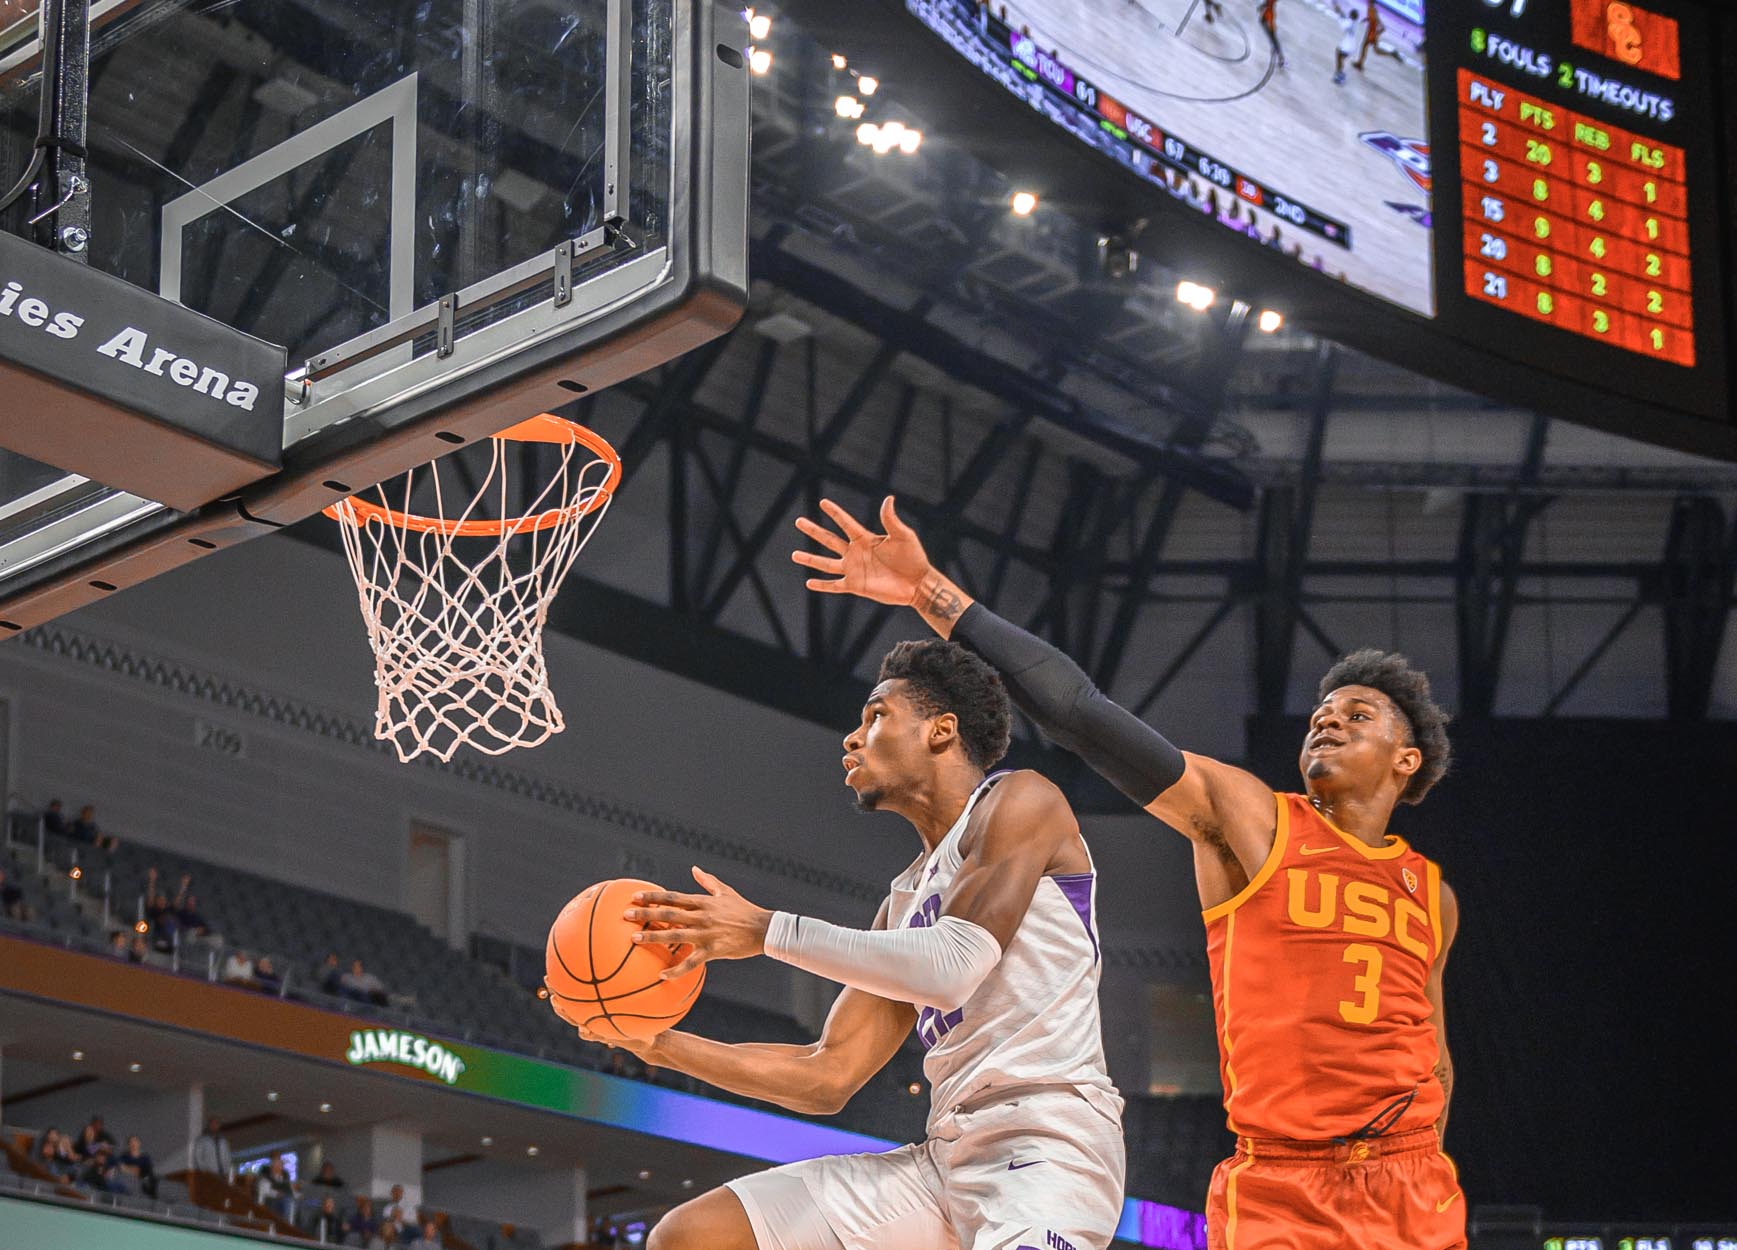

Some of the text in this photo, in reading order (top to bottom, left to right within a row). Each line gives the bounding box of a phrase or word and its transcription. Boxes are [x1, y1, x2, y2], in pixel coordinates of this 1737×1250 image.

[1487, 33, 1552, 78] FOULS
[1558, 62, 1575, 89] 2
[1575, 67, 1676, 122] TIMEOUTS
[1470, 81, 1665, 168] PLY PTS REB FLS
[1482, 122, 1656, 203] 2 20 3 1
[1483, 159, 1499, 183] 3
[1588, 200, 1604, 221] 4
[1645, 218, 1658, 240] 1
[1480, 233, 1507, 260] 20
[1591, 272, 1607, 296] 2
[1647, 290, 1663, 314] 2
[1589, 237, 1606, 258] 4
[1646, 253, 1661, 277] 2
[0, 282, 260, 411] ies Arena
[1483, 272, 1507, 299] 21
[1593, 310, 1609, 333] 3
[1650, 328, 1664, 350] 1
[1287, 868, 1429, 962] USC
[1338, 943, 1383, 1025] 3
[347, 1029, 461, 1085] JAMESON
